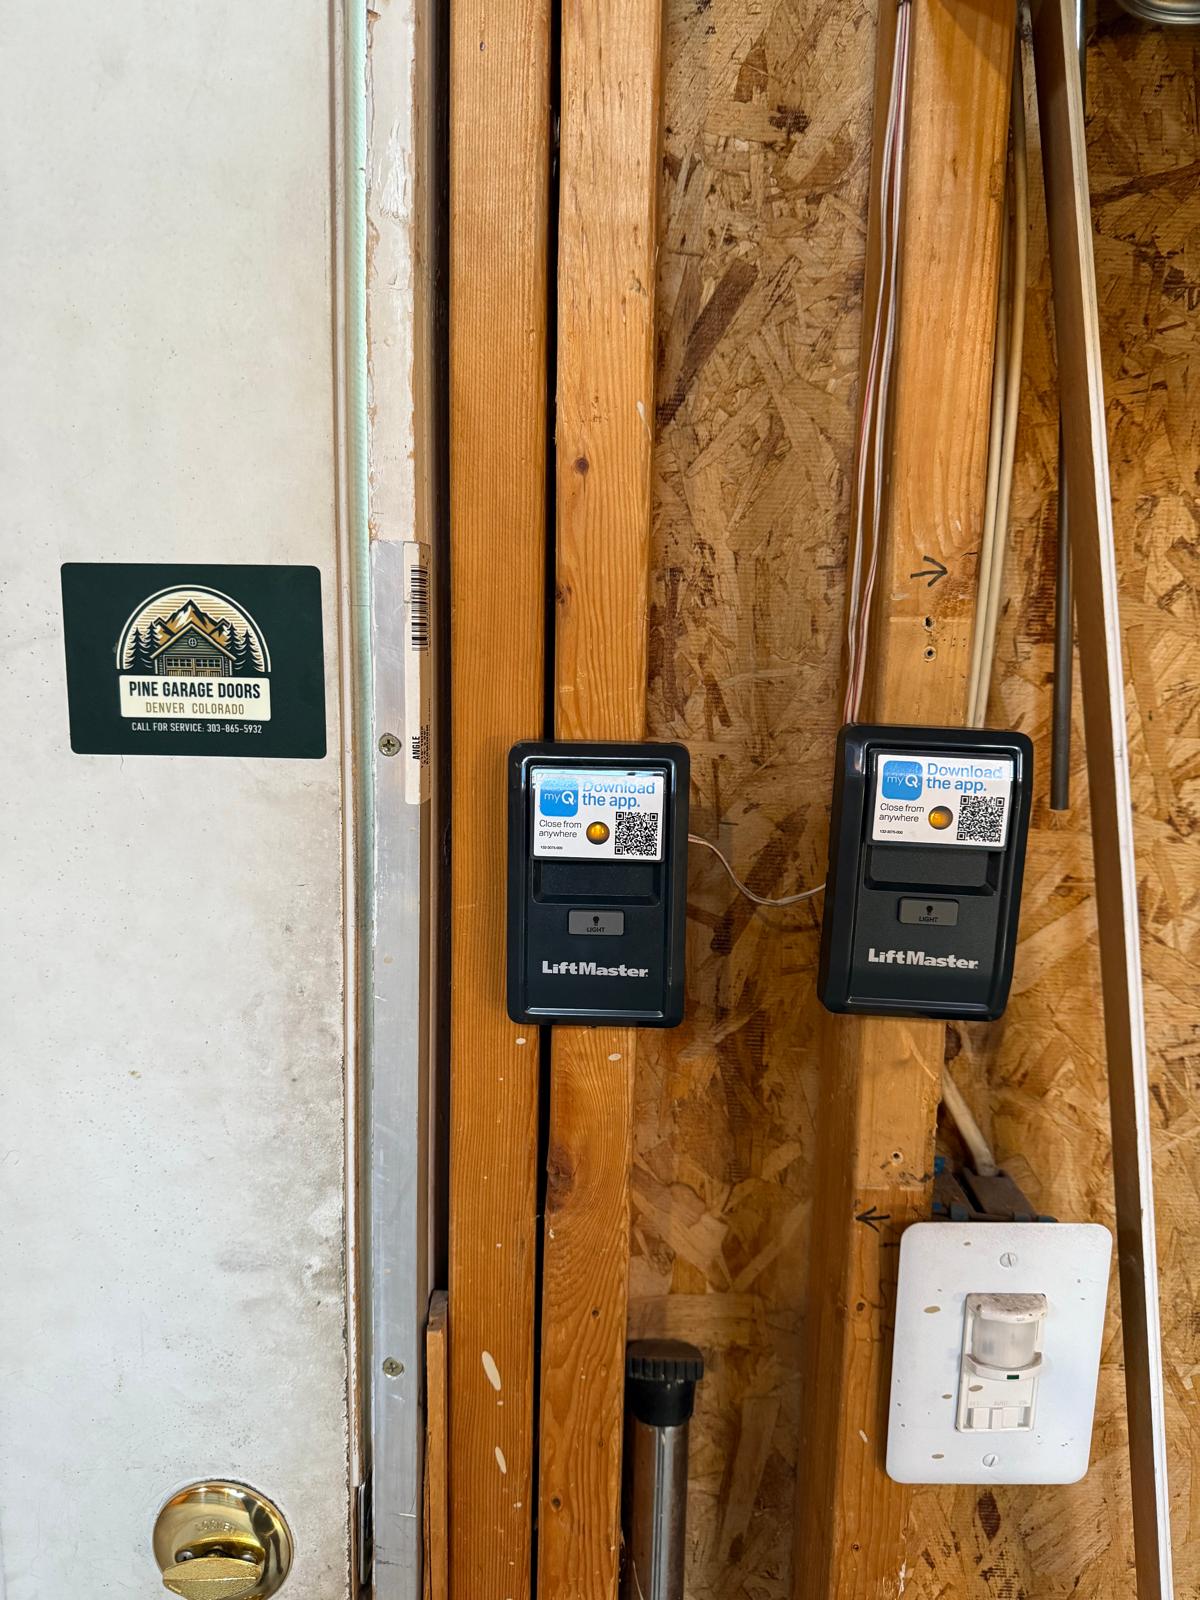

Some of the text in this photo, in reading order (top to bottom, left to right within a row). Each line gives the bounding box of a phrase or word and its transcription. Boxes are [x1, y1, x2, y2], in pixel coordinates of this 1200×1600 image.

[129, 681, 261, 699] PINE GARAGE DOORS
[145, 702, 245, 715] DENVER COLORADO
[131, 722, 151, 732] CALL
[153, 722, 168, 732] FOR
[206, 724, 262, 734] 303-865-5932
[412, 735, 421, 760] ANGLE
[926, 763, 1003, 779] Download
[582, 782, 656, 795] Download
[926, 777, 987, 794] the app.
[582, 793, 641, 810] the app.
[880, 802, 925, 813] Close from
[539, 819, 582, 829] Close from
[879, 813, 920, 823] anywhere
[538, 830, 578, 839] anywhere
[918, 915, 939, 923] LIGHT
[868, 948, 978, 969] LiftMaster
[542, 960, 648, 977] LiftMaster
